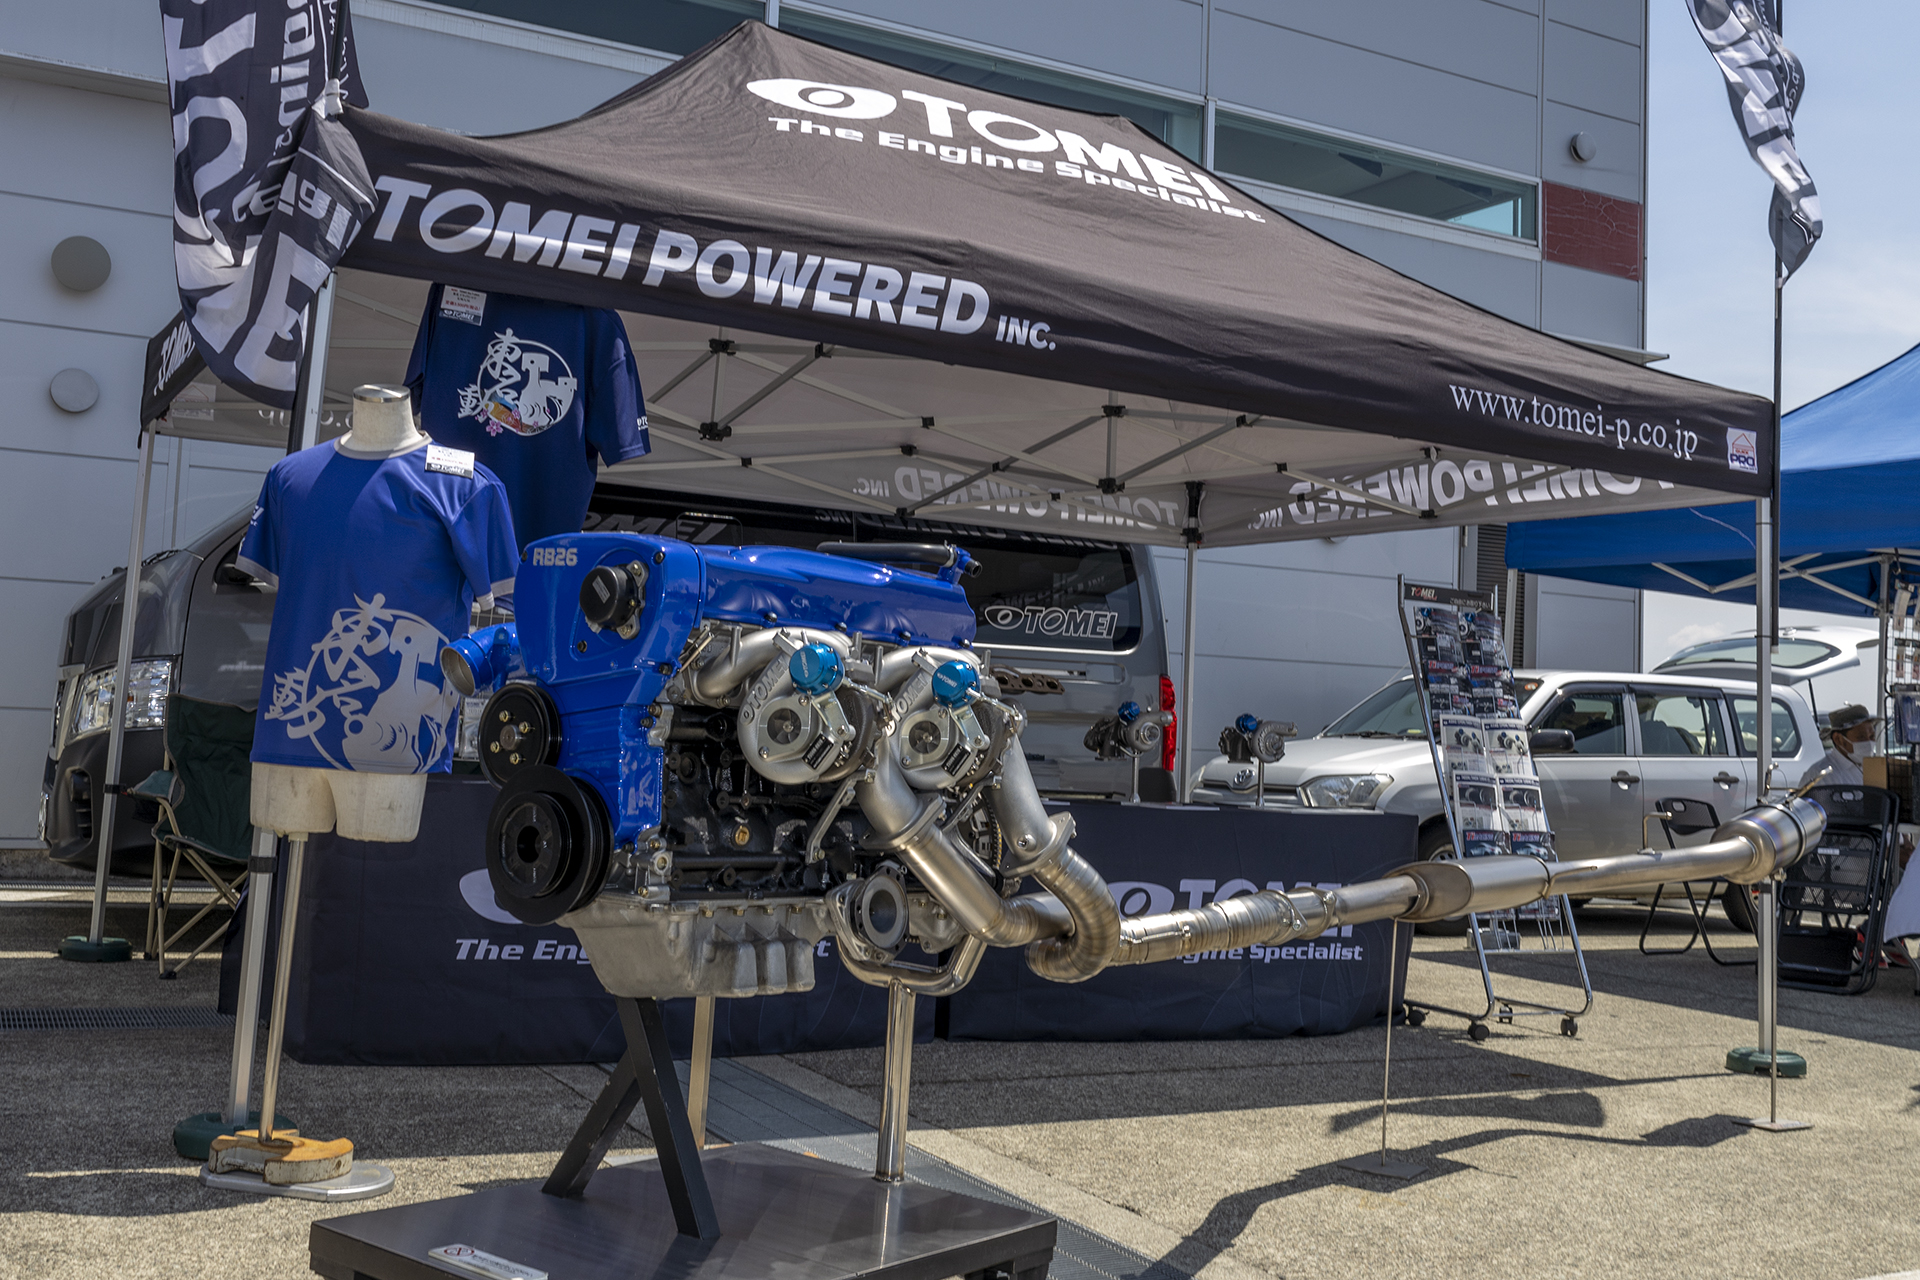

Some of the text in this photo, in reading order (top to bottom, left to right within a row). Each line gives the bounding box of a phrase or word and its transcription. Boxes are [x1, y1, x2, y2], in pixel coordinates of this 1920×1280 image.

[901, 89, 1231, 203] TOMEI
[768, 117, 1266, 224] The Engine Specialist
[372, 175, 641, 280] TOMEI
[643, 229, 990, 335] POWERED
[995, 314, 1057, 351] INC.
[1448, 384, 1698, 461] www.tomei-p.co.jp
[1730, 453, 1755, 467] PRO
[532, 547, 578, 567] RB26
[1411, 586, 1436, 598] TOMEI
[1024, 605, 1119, 640] TOMEI
[455, 938, 523, 961] The
[1249, 940, 1364, 964] Specialist
